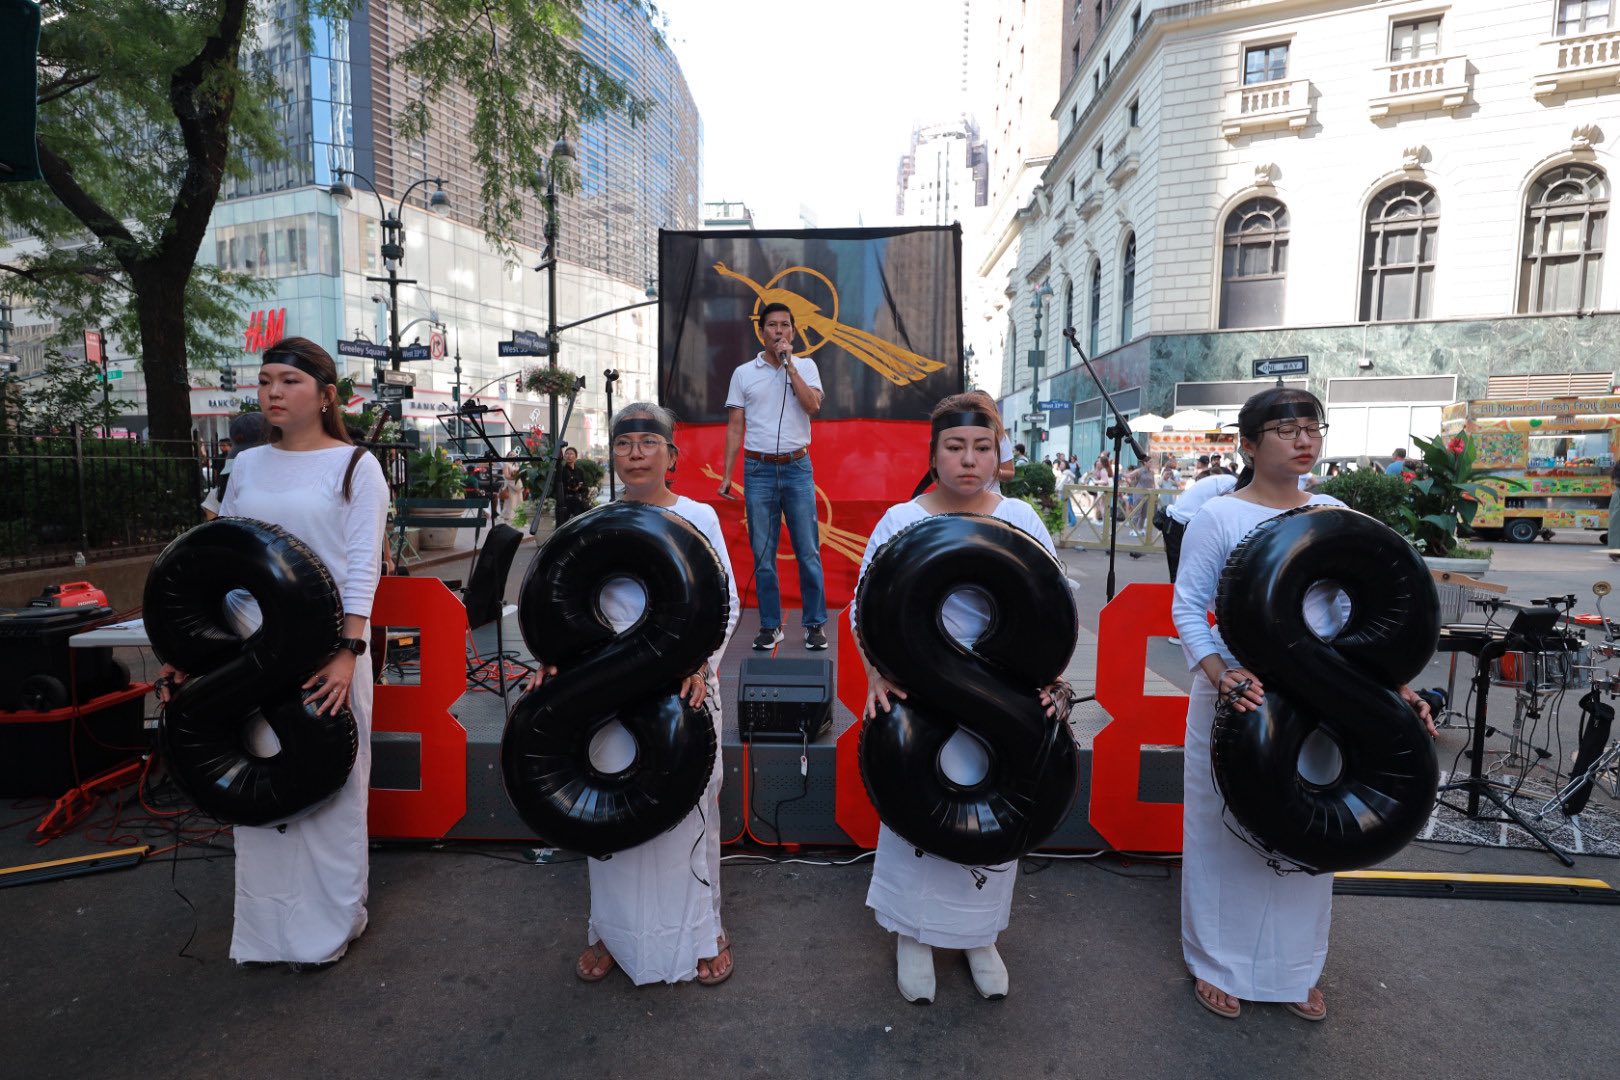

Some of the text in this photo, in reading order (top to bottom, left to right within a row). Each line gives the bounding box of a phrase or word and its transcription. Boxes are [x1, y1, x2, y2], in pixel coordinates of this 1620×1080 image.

[244, 307, 286, 353] H&M
[515, 335, 532, 348] Greeley
[532, 339, 548, 350] Square
[340, 343, 364, 355] Greeley
[365, 347, 387, 358] Square
[402, 350, 413, 359] West
[1283, 363, 1299, 371] WAY
[209, 399, 229, 408] BANK
[410, 401, 436, 411] BANK
